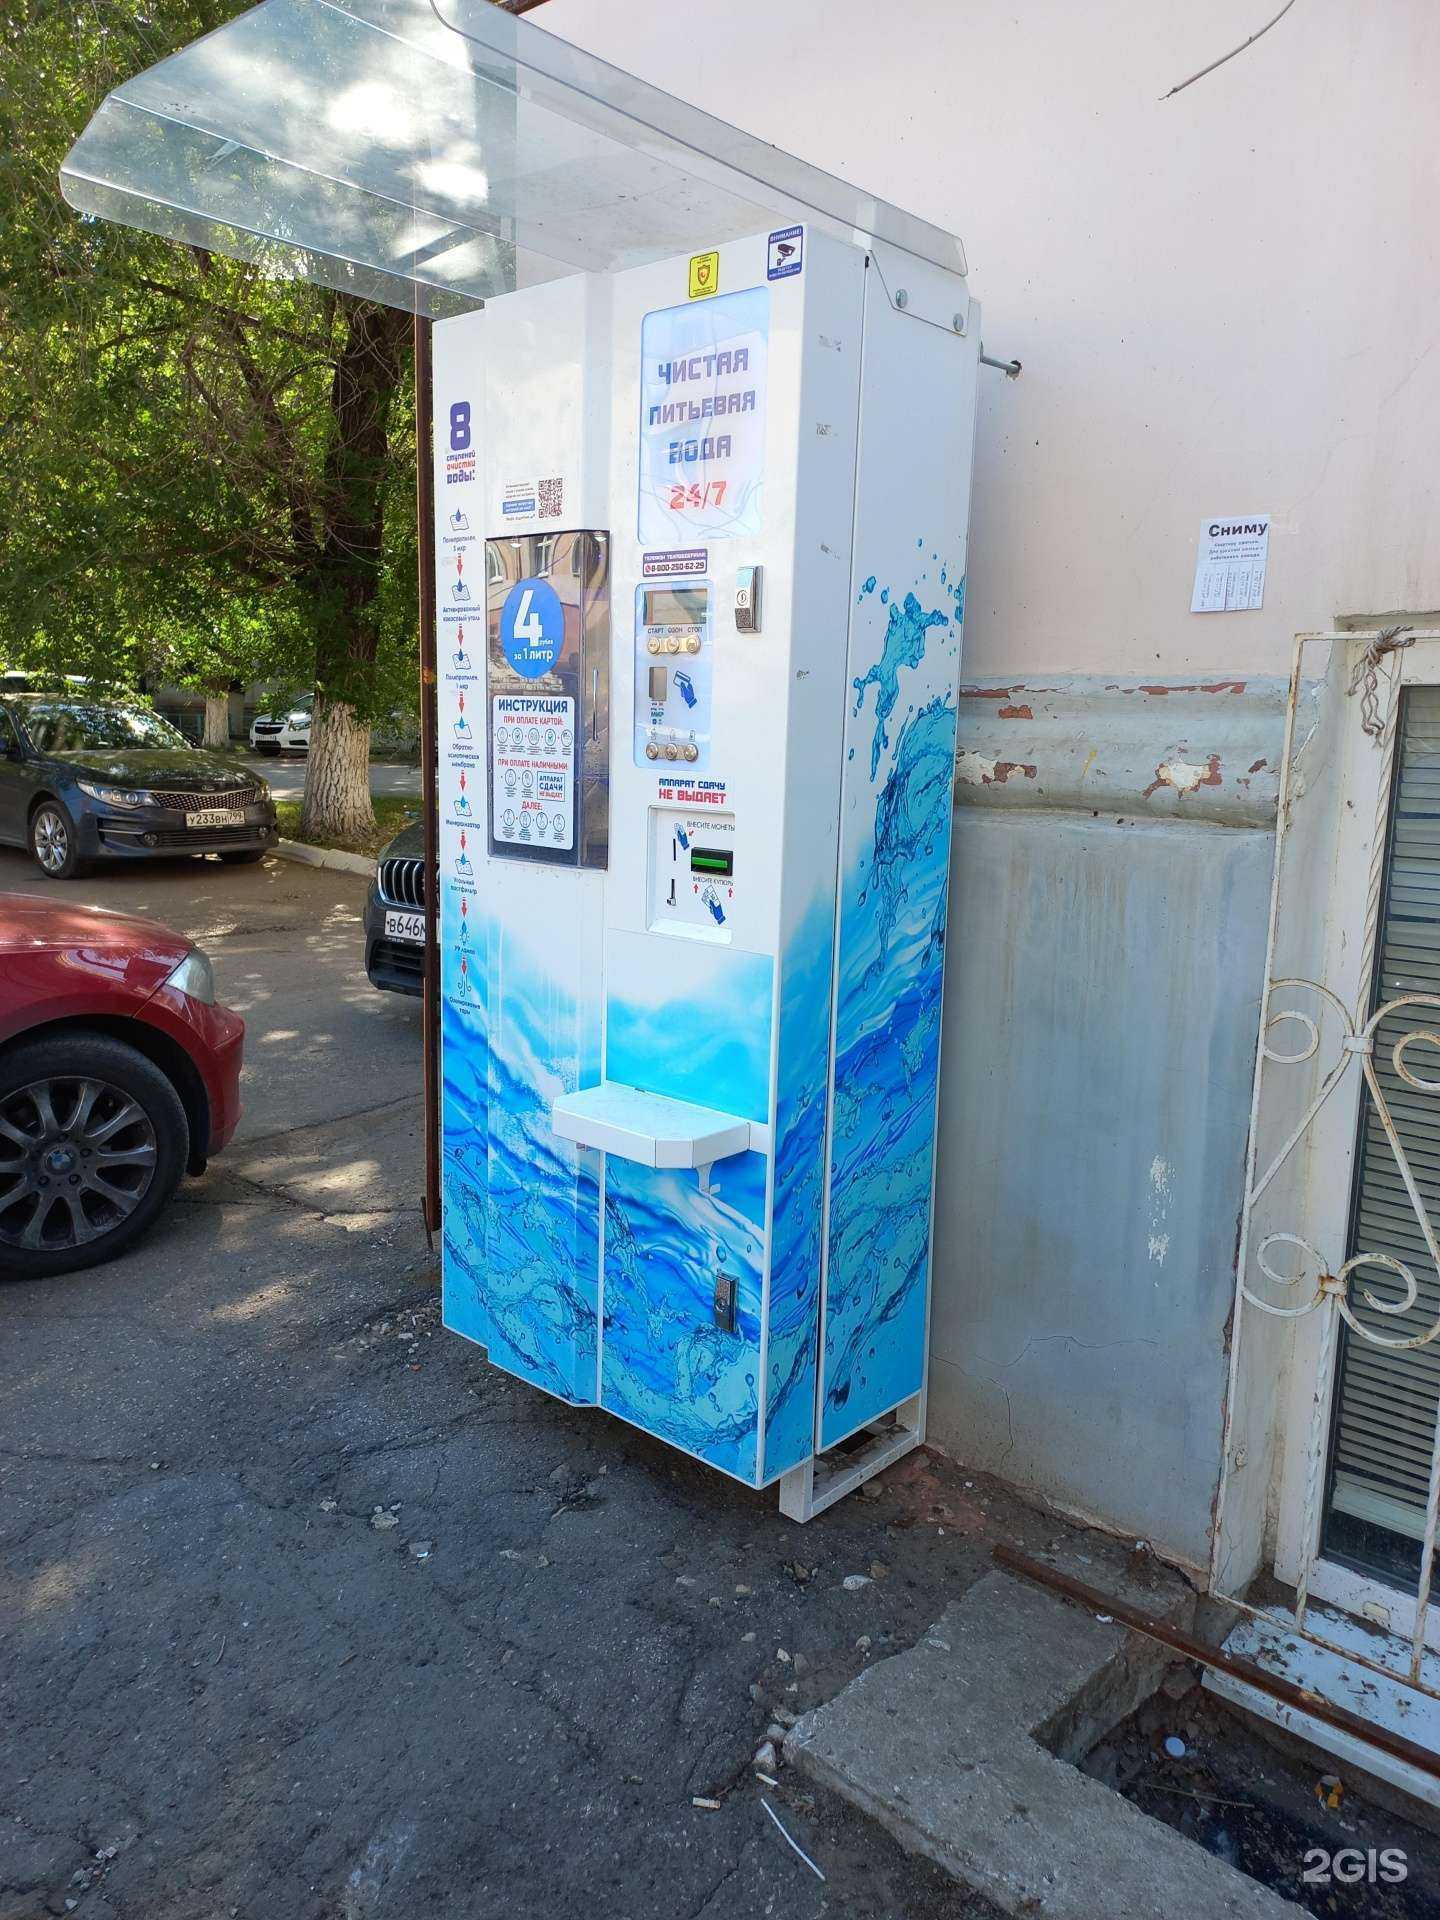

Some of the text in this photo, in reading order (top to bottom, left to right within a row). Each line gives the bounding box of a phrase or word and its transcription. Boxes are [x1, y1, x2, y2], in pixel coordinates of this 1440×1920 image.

[658, 348, 749, 384] ЧИСТАЯ
[649, 390, 756, 425] ПИТЬЕВАЯ
[450, 401, 471, 451] 8
[669, 435, 731, 464] ВОДА
[446, 460, 476, 471] очистки
[446, 469, 476, 484] воды:
[669, 480, 727, 510] 24/7
[1208, 523, 1268, 537] Сниму
[513, 590, 543, 647] 4
[523, 648, 528, 660] 1
[529, 650, 553, 663] литр
[498, 698, 568, 714] ИНСТРУКЦИЯ
[503, 715, 515, 724] ПРИ
[516, 716, 539, 725] ОПЛАТЕ
[497, 758, 509, 767] ПРИ
[509, 759, 531, 768] ОПЛАТЕ
[539, 775, 563, 783] АППАРАТ
[539, 782, 563, 791] СДАЧИ
[658, 778, 726, 790] АППАРАТ СДАЧУ
[659, 788, 727, 804] НЕ ВЫДАЕТ
[521, 801, 543, 811] ДАЛЕЕ:
[686, 820, 735, 832] ВНЕСИТЕ МОНЕТЫ
